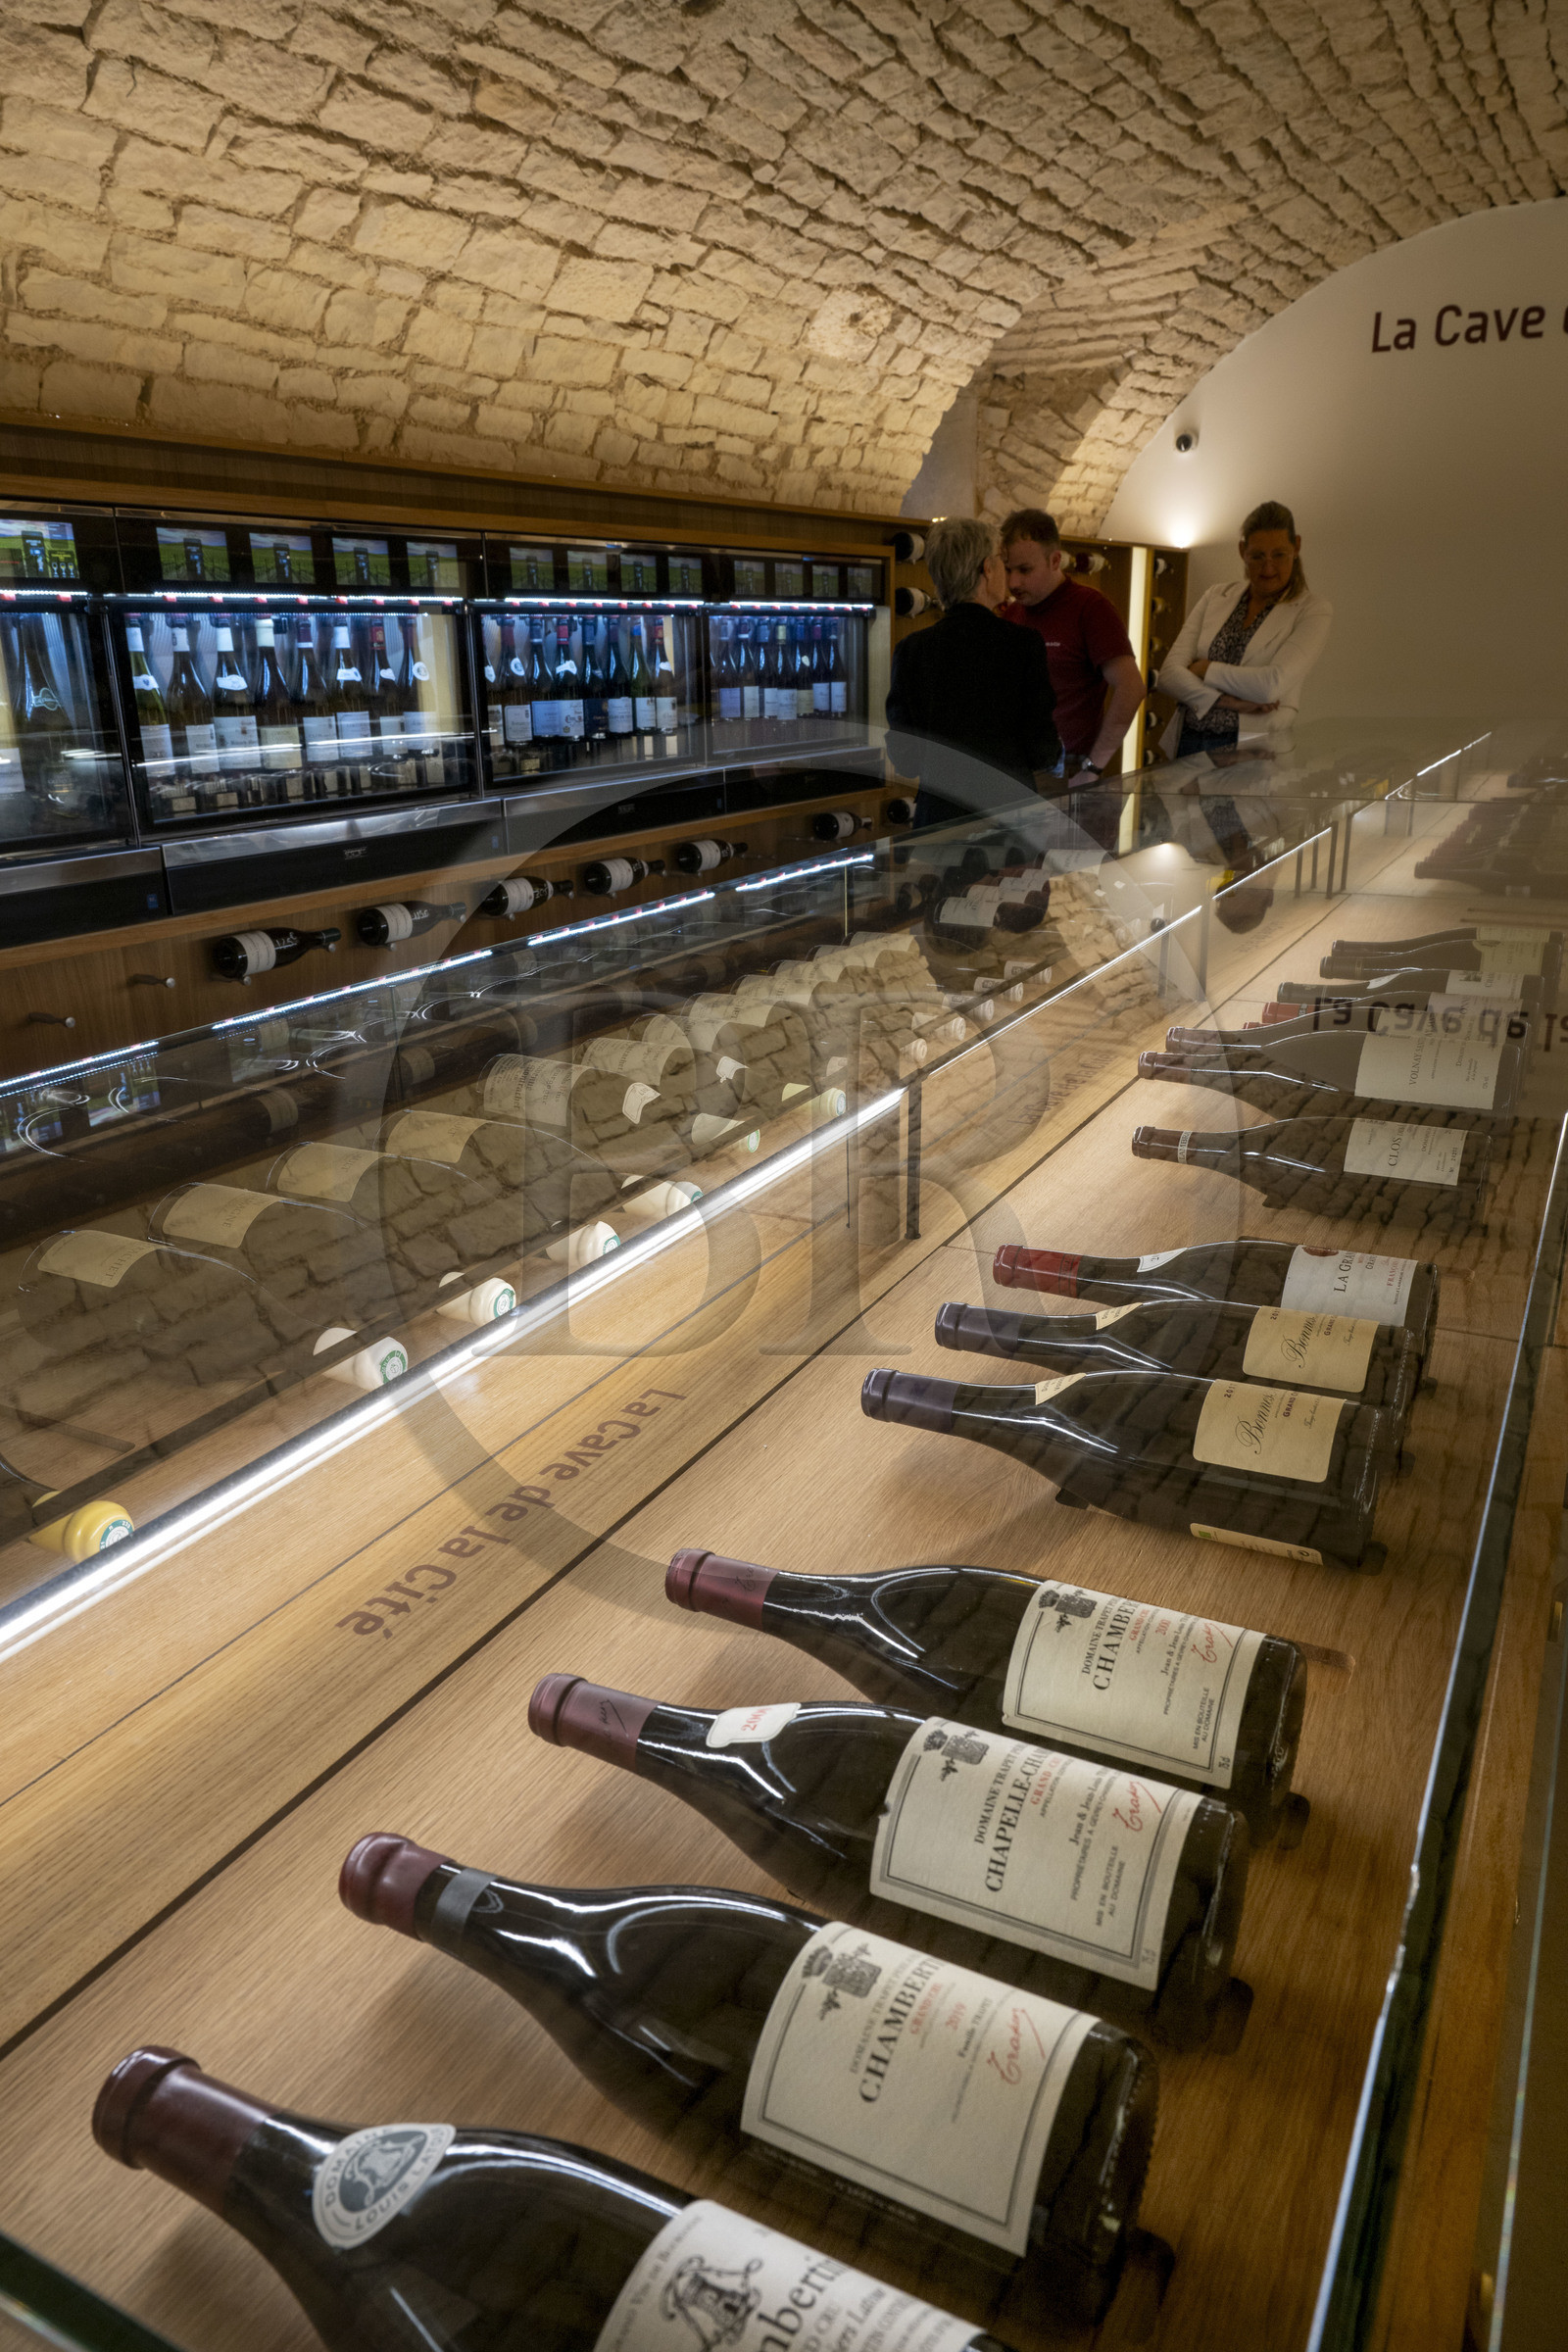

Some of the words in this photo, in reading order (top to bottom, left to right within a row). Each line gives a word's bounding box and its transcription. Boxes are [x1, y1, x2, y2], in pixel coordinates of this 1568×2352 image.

[1372, 312, 1417, 353] La
[1435, 304, 1545, 347] Cave
[1388, 1137, 1401, 1166] CLOS
[1333, 1276, 1348, 1293] LA
[621, 1388, 687, 1420] La
[539, 1420, 642, 1481] Cave
[485, 1485, 556, 1522] de
[437, 1525, 512, 1558] la
[334, 1564, 458, 1641] Cité
[1082, 1632, 1102, 1674] DOMAINE
[1095, 1607, 1113, 1631] TRAPET
[1128, 1618, 1144, 1641] GRAND
[1160, 1657, 1171, 1676] Jean
[1197, 1688, 1210, 1724] BOUTEILLE
[1203, 1698, 1215, 1731] DOMAINE
[1195, 1725, 1201, 1736] EN
[1202, 1732, 1208, 1741] AU
[974, 1787, 1001, 1844] DOMAINE
[992, 1753, 1018, 1787] TRAPET
[1029, 1770, 1053, 1804] GRAND
[1075, 1811, 1087, 1821] &
[1068, 1821, 1085, 1845] Jean
[1070, 1838, 1092, 1900] PROPRIÉTAIRES
[1102, 1845, 1118, 1890] BOUTEILLE
[1111, 1861, 1126, 1900] DOMAINE
[1100, 1894, 1106, 1906] EN
[1108, 1904, 1116, 1918] AU
[1096, 1910, 1104, 1926] MIS
[355, 2182, 410, 2231] LOUIS
